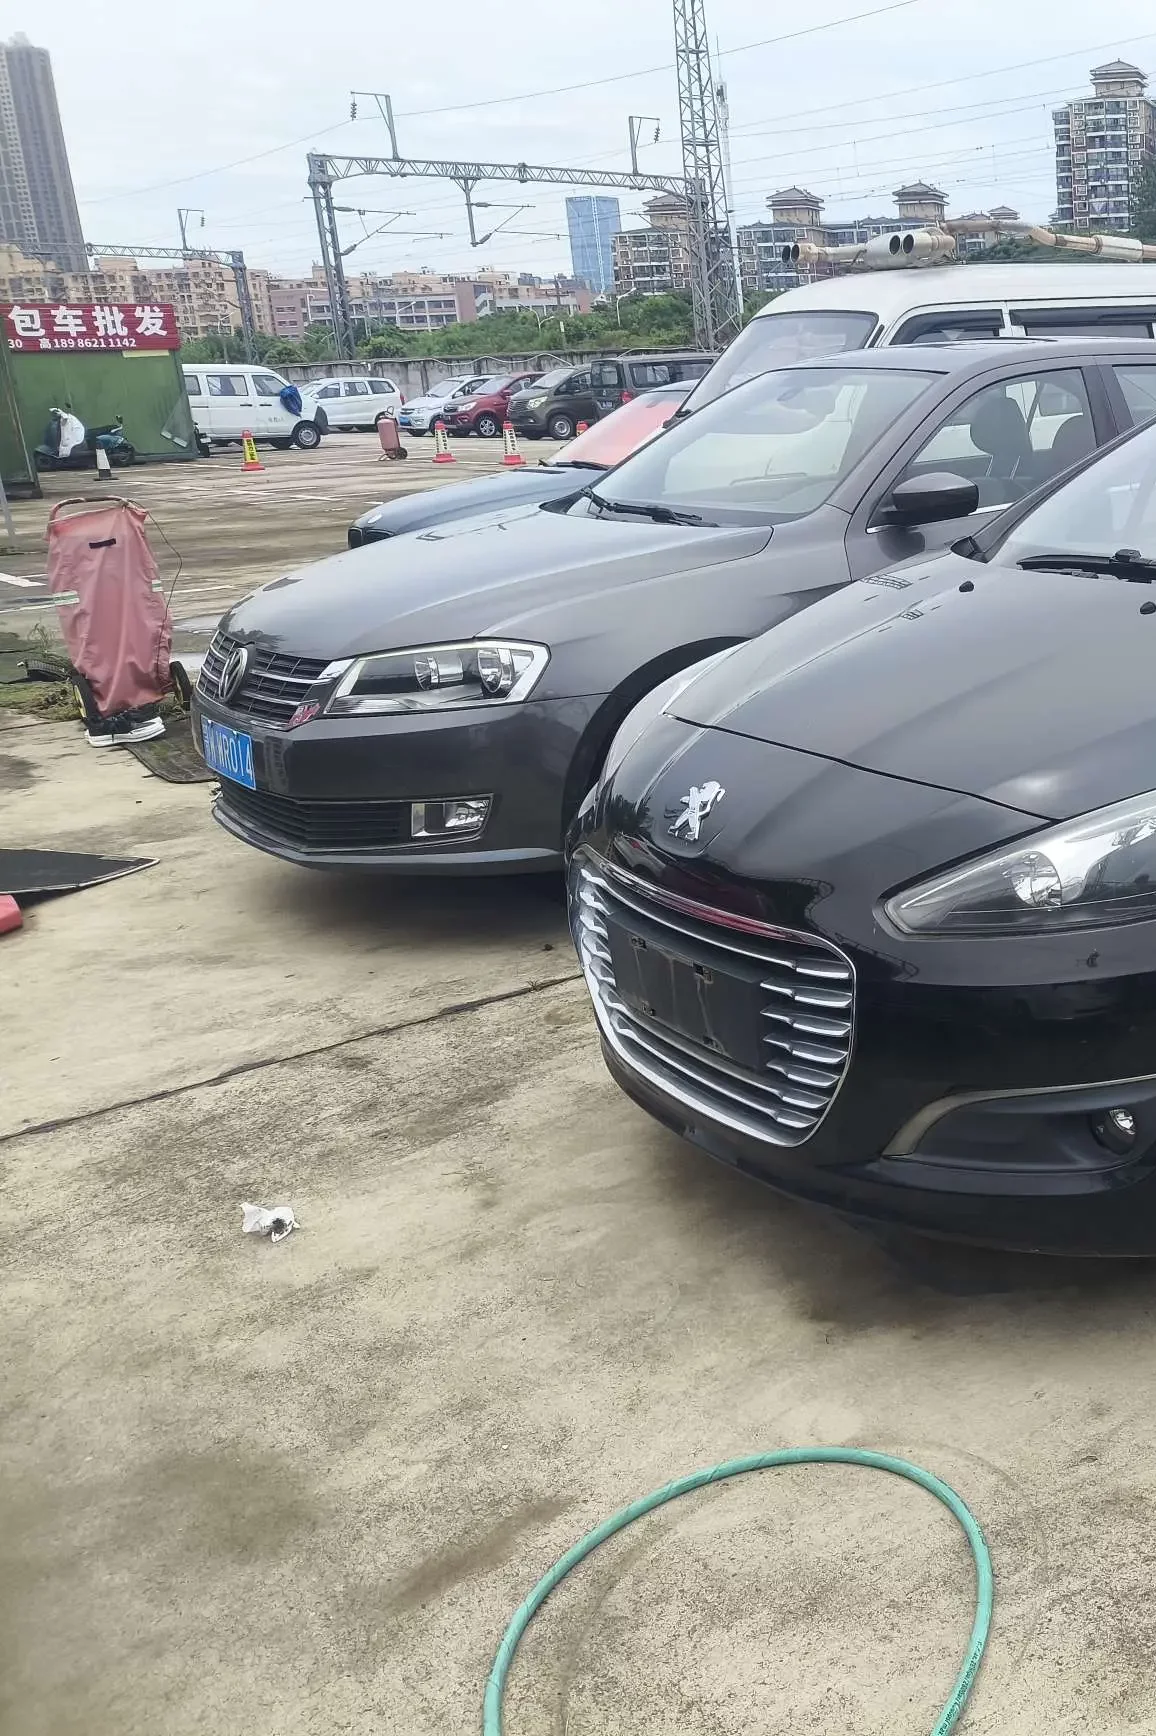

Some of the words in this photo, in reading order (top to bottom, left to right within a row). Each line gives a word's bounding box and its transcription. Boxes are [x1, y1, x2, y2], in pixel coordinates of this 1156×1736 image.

[8, 305, 168, 337] 包车批发
[77, 338, 107, 348] 8621
[109, 338, 137, 348] 1142
